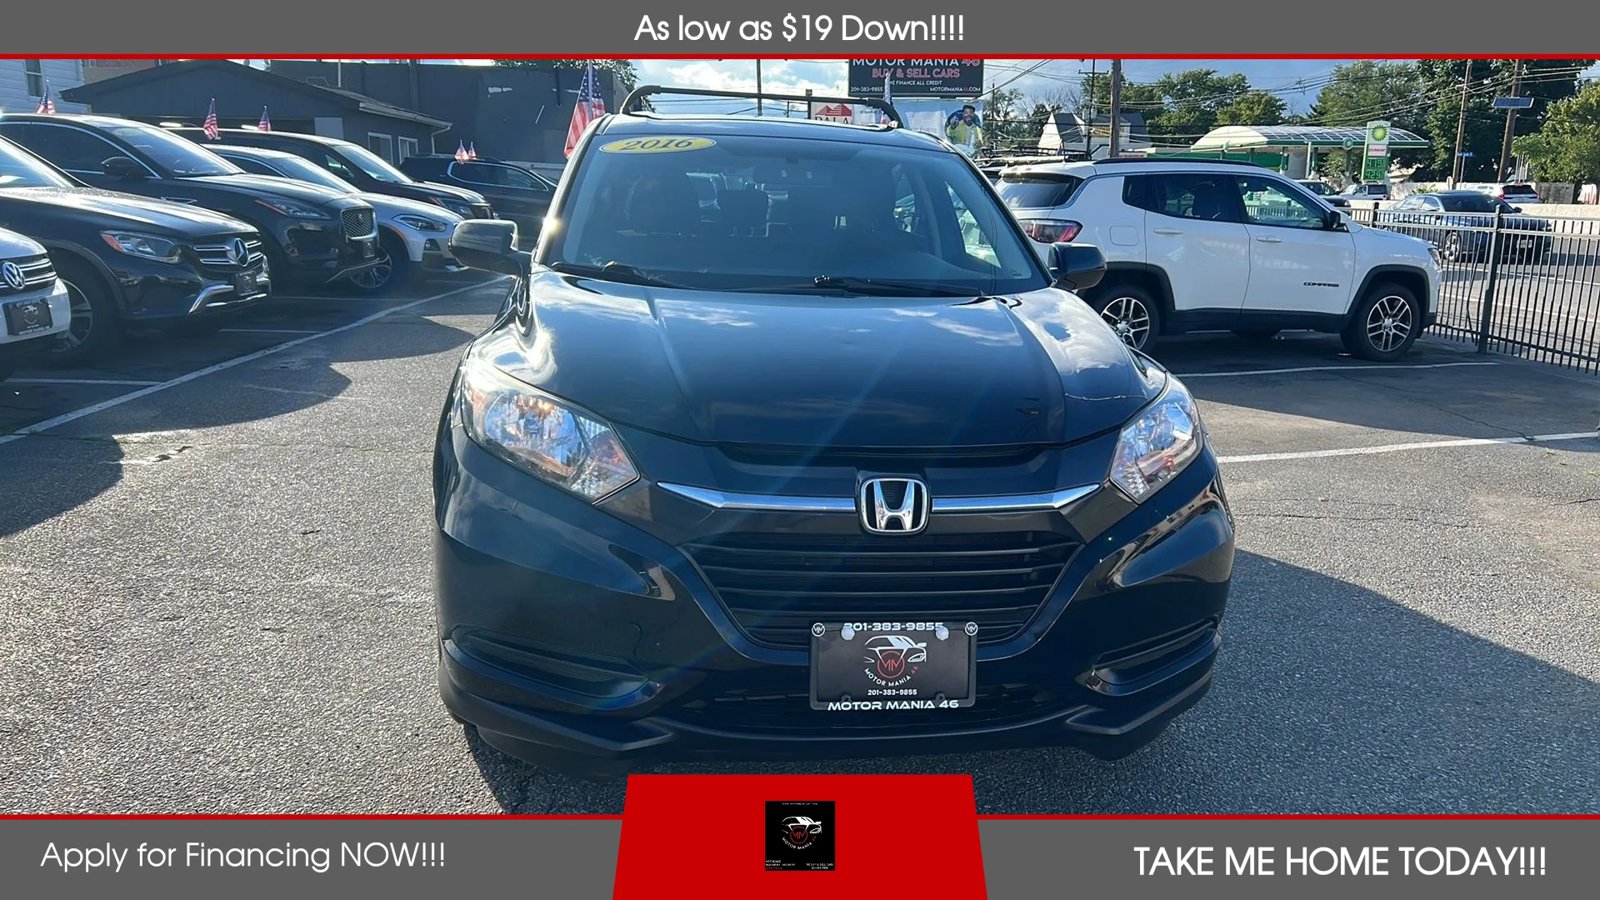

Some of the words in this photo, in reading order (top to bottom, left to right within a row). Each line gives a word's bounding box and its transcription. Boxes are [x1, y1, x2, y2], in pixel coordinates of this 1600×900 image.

[852, 59, 905, 67] MOTOR
[911, 59, 959, 67] MANIA
[872, 68, 895, 78] BUY
[906, 68, 932, 78] SELL
[932, 68, 960, 78] CARS
[619, 139, 693, 151] 2016
[864, 667, 887, 686] MOTOR
[888, 674, 911, 687] MANIA
[867, 688, 918, 696] 201-383-9855
[827, 701, 882, 711] MOTOR
[886, 700, 936, 710] MANIA
[938, 699, 959, 709] 46
